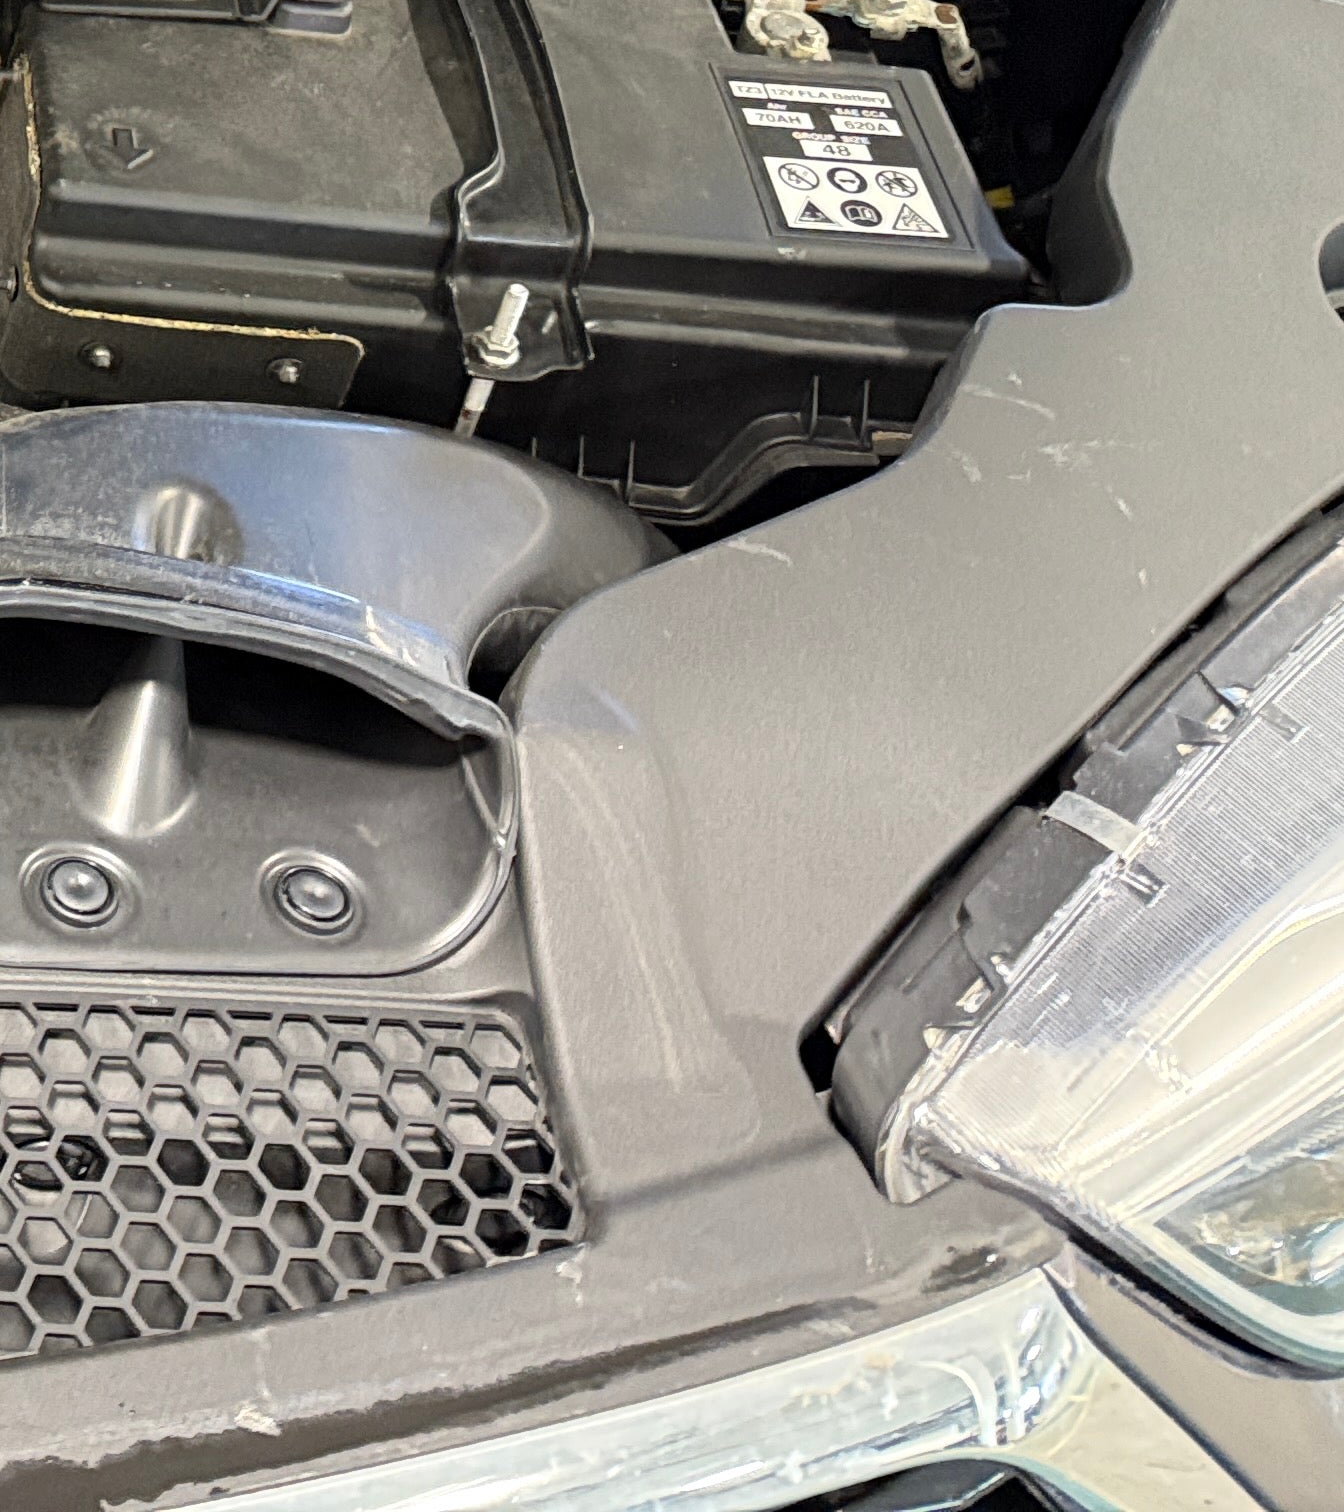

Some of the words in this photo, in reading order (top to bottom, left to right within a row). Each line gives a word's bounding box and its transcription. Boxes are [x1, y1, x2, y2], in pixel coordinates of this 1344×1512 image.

[771, 88, 794, 96] 12V
[798, 90, 829, 100] FLA
[832, 93, 885, 105] Battery
[755, 113, 801, 124] 70AH
[845, 121, 890, 132] 620A
[823, 145, 851, 157] 48
